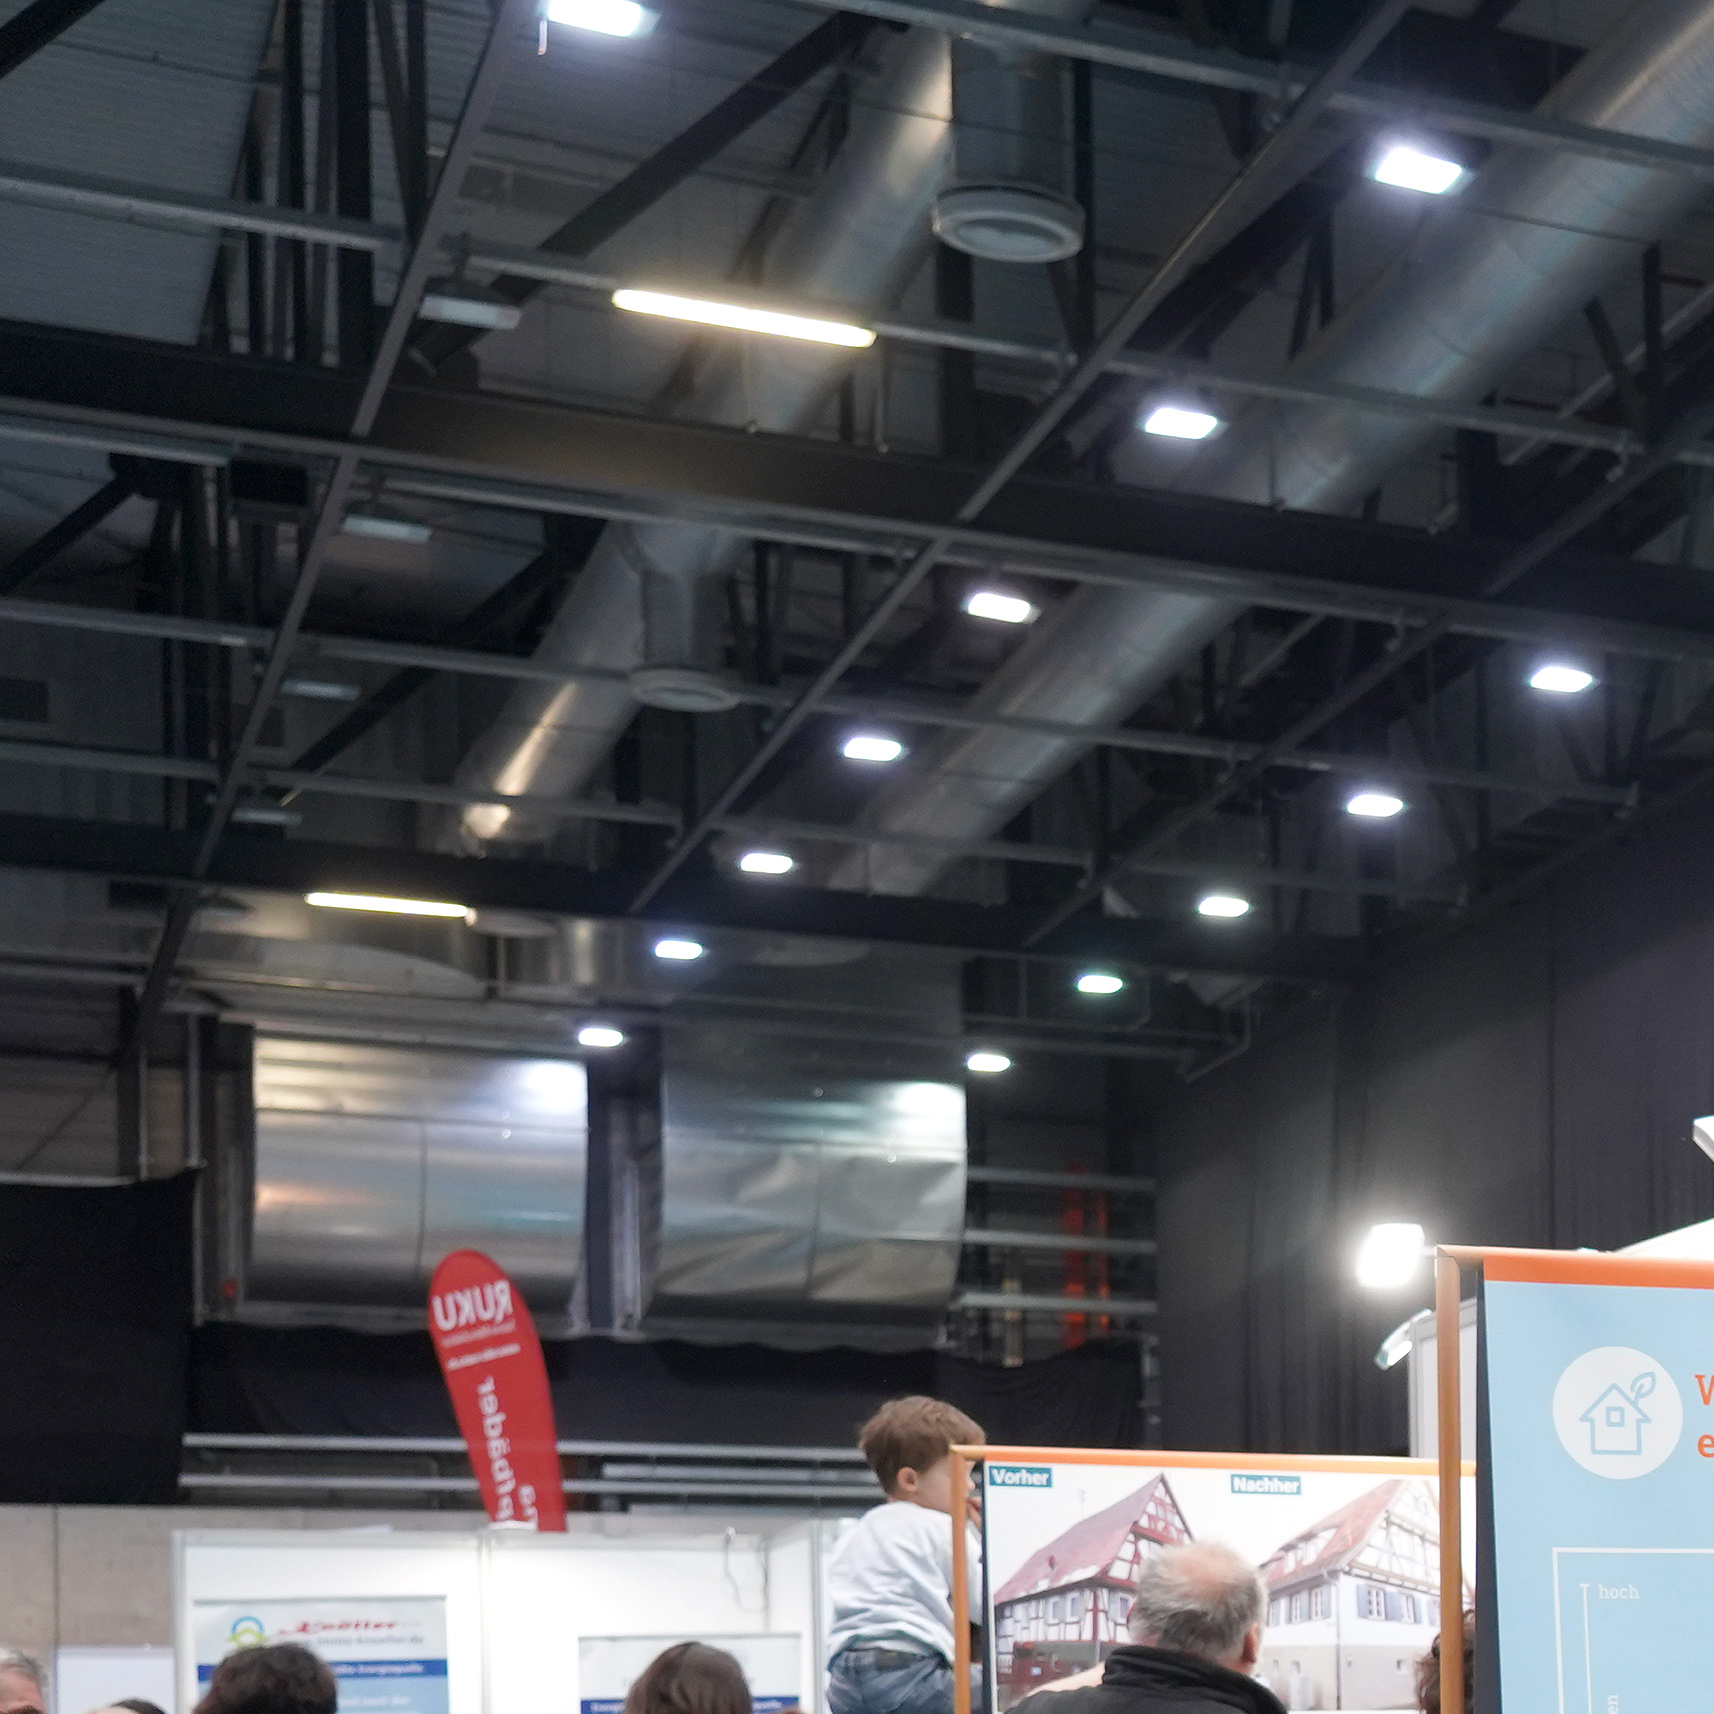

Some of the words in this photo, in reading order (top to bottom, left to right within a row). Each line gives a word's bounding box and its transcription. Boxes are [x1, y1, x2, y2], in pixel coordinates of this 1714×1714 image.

[992, 1469, 1049, 1486] Vorher
[1234, 1477, 1299, 1494] Nachher
[1598, 1584, 1640, 1599] hoch
